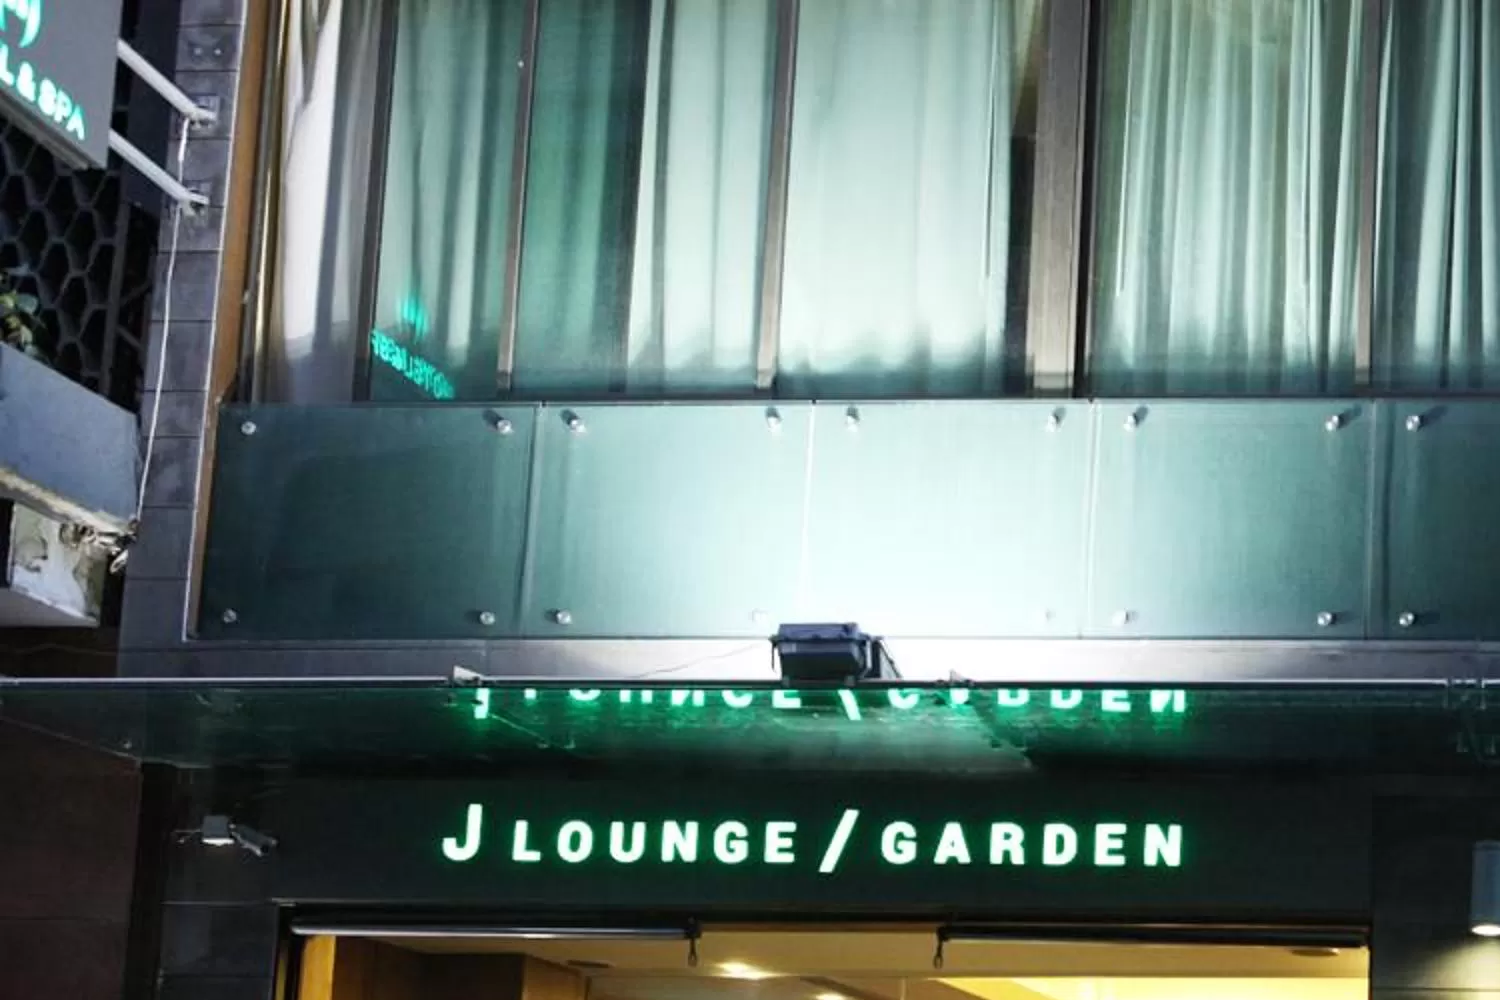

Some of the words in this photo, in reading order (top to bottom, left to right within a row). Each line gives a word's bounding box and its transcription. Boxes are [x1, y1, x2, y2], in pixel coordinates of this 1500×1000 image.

[38, 77, 85, 140] SPA
[441, 802, 484, 862] J
[511, 819, 798, 865] LOUNGE
[880, 820, 1183, 868] GARDEN
